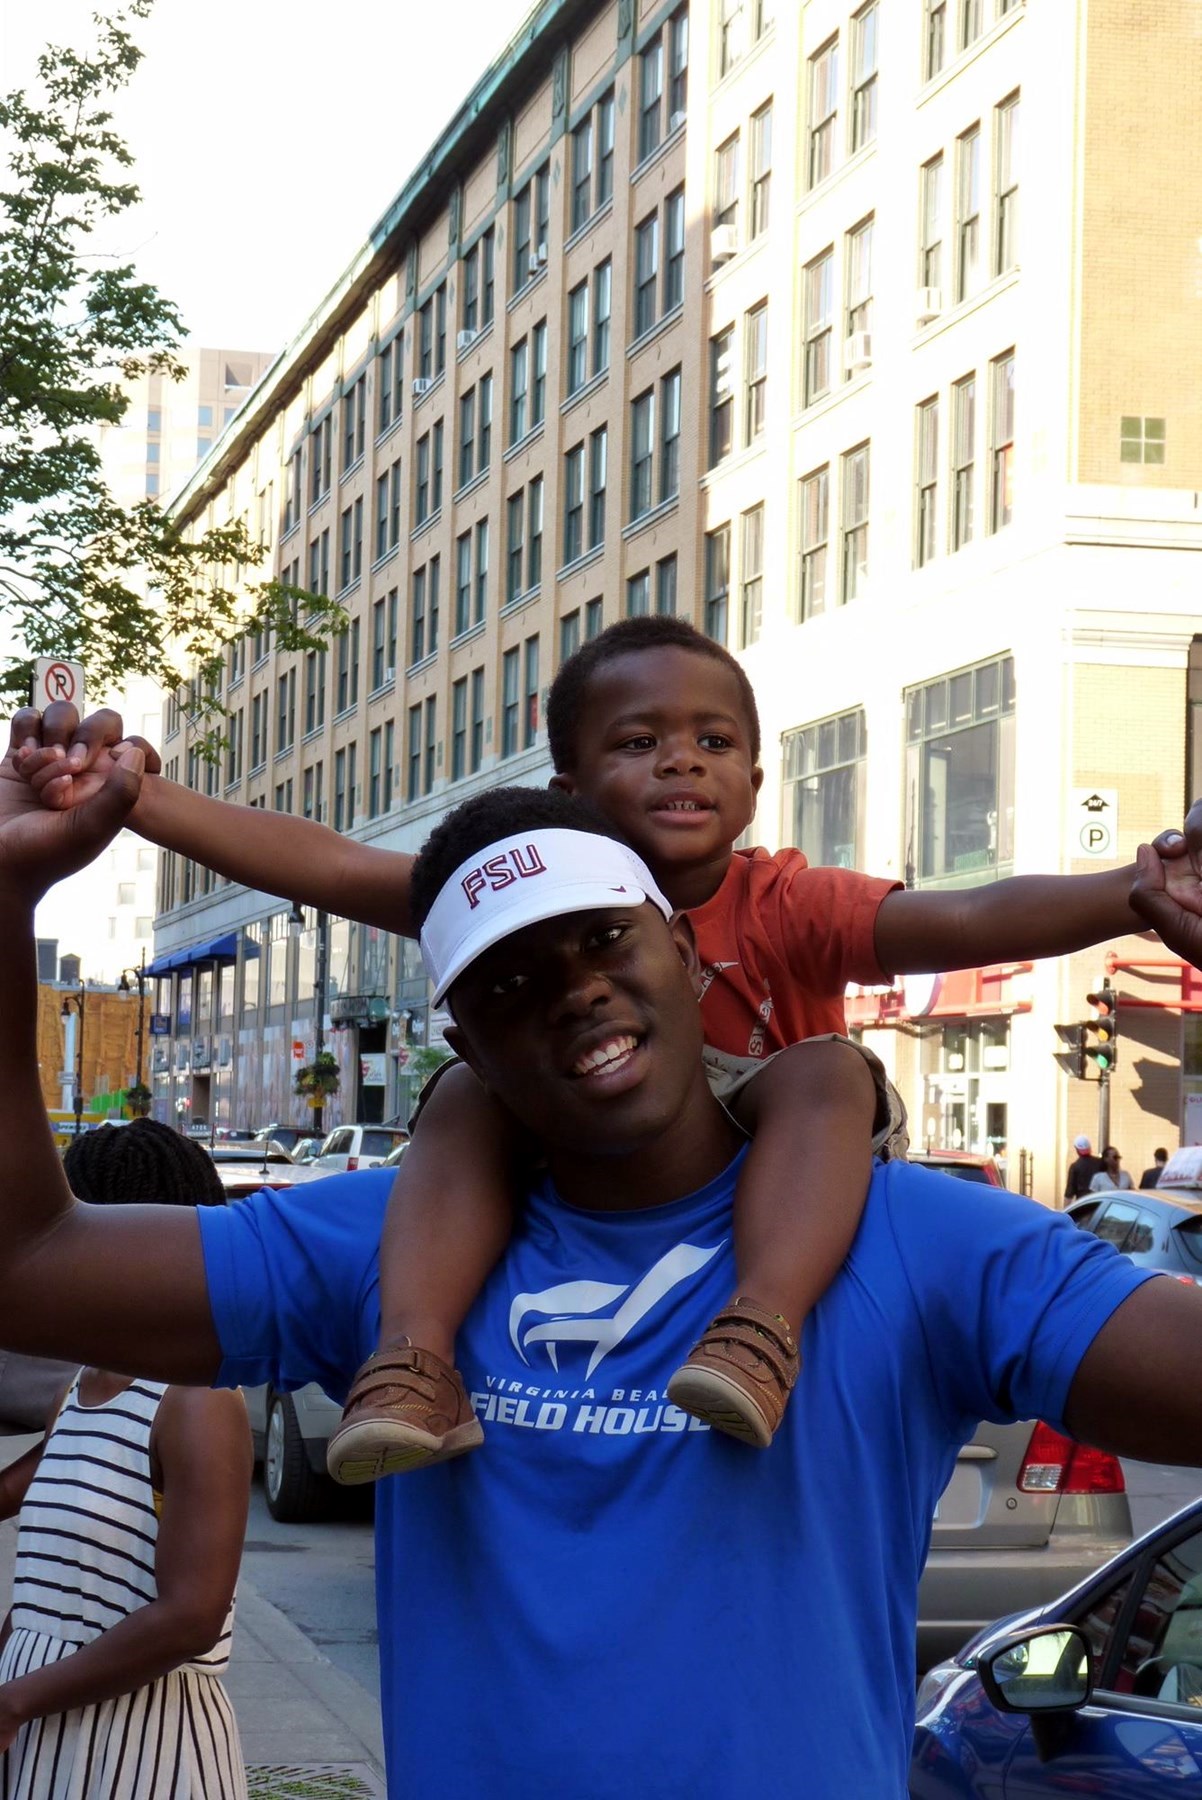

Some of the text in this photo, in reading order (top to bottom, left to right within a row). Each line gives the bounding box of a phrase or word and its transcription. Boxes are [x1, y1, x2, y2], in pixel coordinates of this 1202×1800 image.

[56, 674, 67, 695] P
[1089, 829, 1104, 847] P
[461, 844, 547, 910] FSU
[486, 1375, 595, 1399] VIRGINIA
[470, 1391, 568, 1430] FIELD
